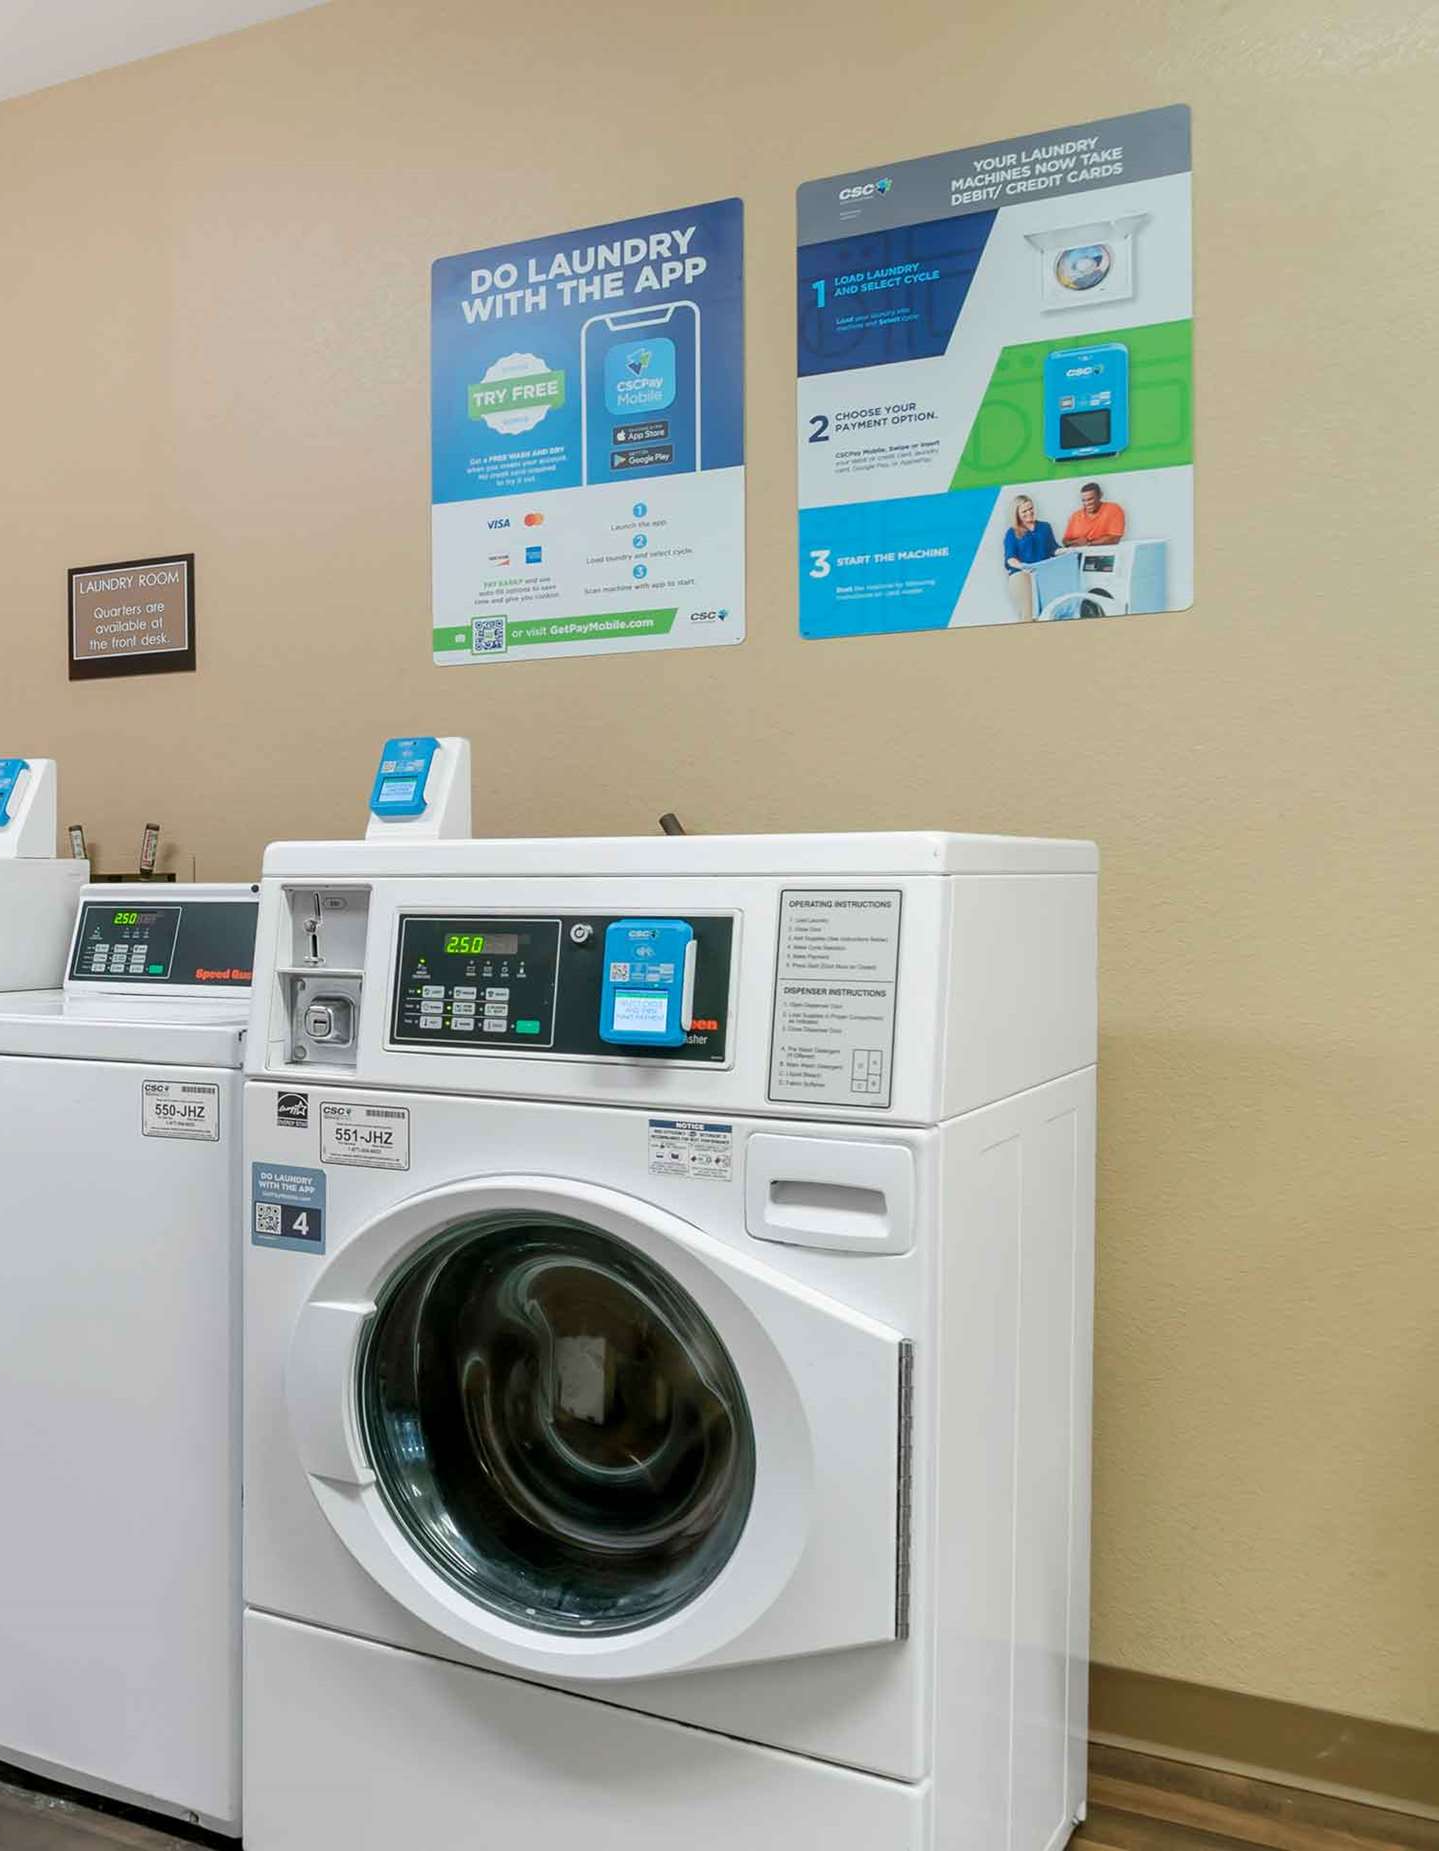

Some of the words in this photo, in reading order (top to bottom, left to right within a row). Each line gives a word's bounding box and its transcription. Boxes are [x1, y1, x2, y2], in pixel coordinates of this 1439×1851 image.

[973, 153, 1017, 172] YOUR
[1021, 136, 1099, 163] LAUNDRY
[951, 165, 1031, 192] MACHINES
[1035, 156, 1076, 174] NOW
[1080, 147, 1123, 166] TAKE
[839, 183, 875, 200] CSC
[951, 184, 1002, 206] DEBIT/
[1005, 174, 1063, 195] CREDIT
[1067, 162, 1123, 183] CARDS
[471, 263, 518, 295] DO
[528, 226, 696, 283] LAUNDRY
[834, 272, 864, 286] LOAD
[866, 262, 920, 279] LAUNDRY
[462, 286, 546, 324] WITH
[557, 271, 624, 306] THE
[634, 257, 707, 293] APP
[834, 284, 858, 297] AND
[861, 277, 901, 292] SELECT
[904, 270, 940, 284] CYCLE
[812, 279, 826, 308] 1
[473, 388, 507, 407] TRY
[512, 381, 558, 401] FREE
[617, 390, 664, 406] Mobile
[835, 407, 882, 421] CHOOSE
[885, 402, 917, 414] YOUR
[808, 415, 830, 443] 2
[835, 418, 888, 432] PAYMENT
[487, 518, 511, 529] VISA
[809, 549, 831, 578] 3
[836, 555, 870, 567] START
[874, 552, 895, 564] THE
[898, 547, 949, 560] MACHINE
[80, 576, 134, 595] LAUNDRY
[139, 570, 180, 587] ROOM
[94, 605, 142, 619] Quarters
[145, 602, 165, 614] are
[690, 610, 717, 622] CSC
[96, 620, 146, 635] available
[151, 617, 163, 629] at
[512, 629, 524, 638] or
[526, 625, 548, 637] visit
[550, 617, 654, 637] GetPayMobile.com
[89, 638, 108, 651] the
[111, 636, 137, 649] front
[788, 900, 832, 909] OPERATING
[834, 900, 892, 909] INSTRUCTIONS
[447, 936, 484, 953] 2.50
[783, 986, 827, 997] DISPENSER
[828, 988, 887, 998] INSTRUCTIONS
[686, 1034, 708, 1045] sher
[145, 1084, 164, 1092] CSC
[155, 1104, 206, 1118] 550-JHZ
[323, 1106, 345, 1115] CSC
[335, 1128, 393, 1145] 551-JHZ
[258, 1180, 280, 1190] WITH
[281, 1183, 297, 1192] THE
[298, 1185, 316, 1194] APP
[260, 1172, 273, 1180] DO
[274, 1174, 313, 1185] LAUNDRY
[292, 1212, 310, 1235] 4
